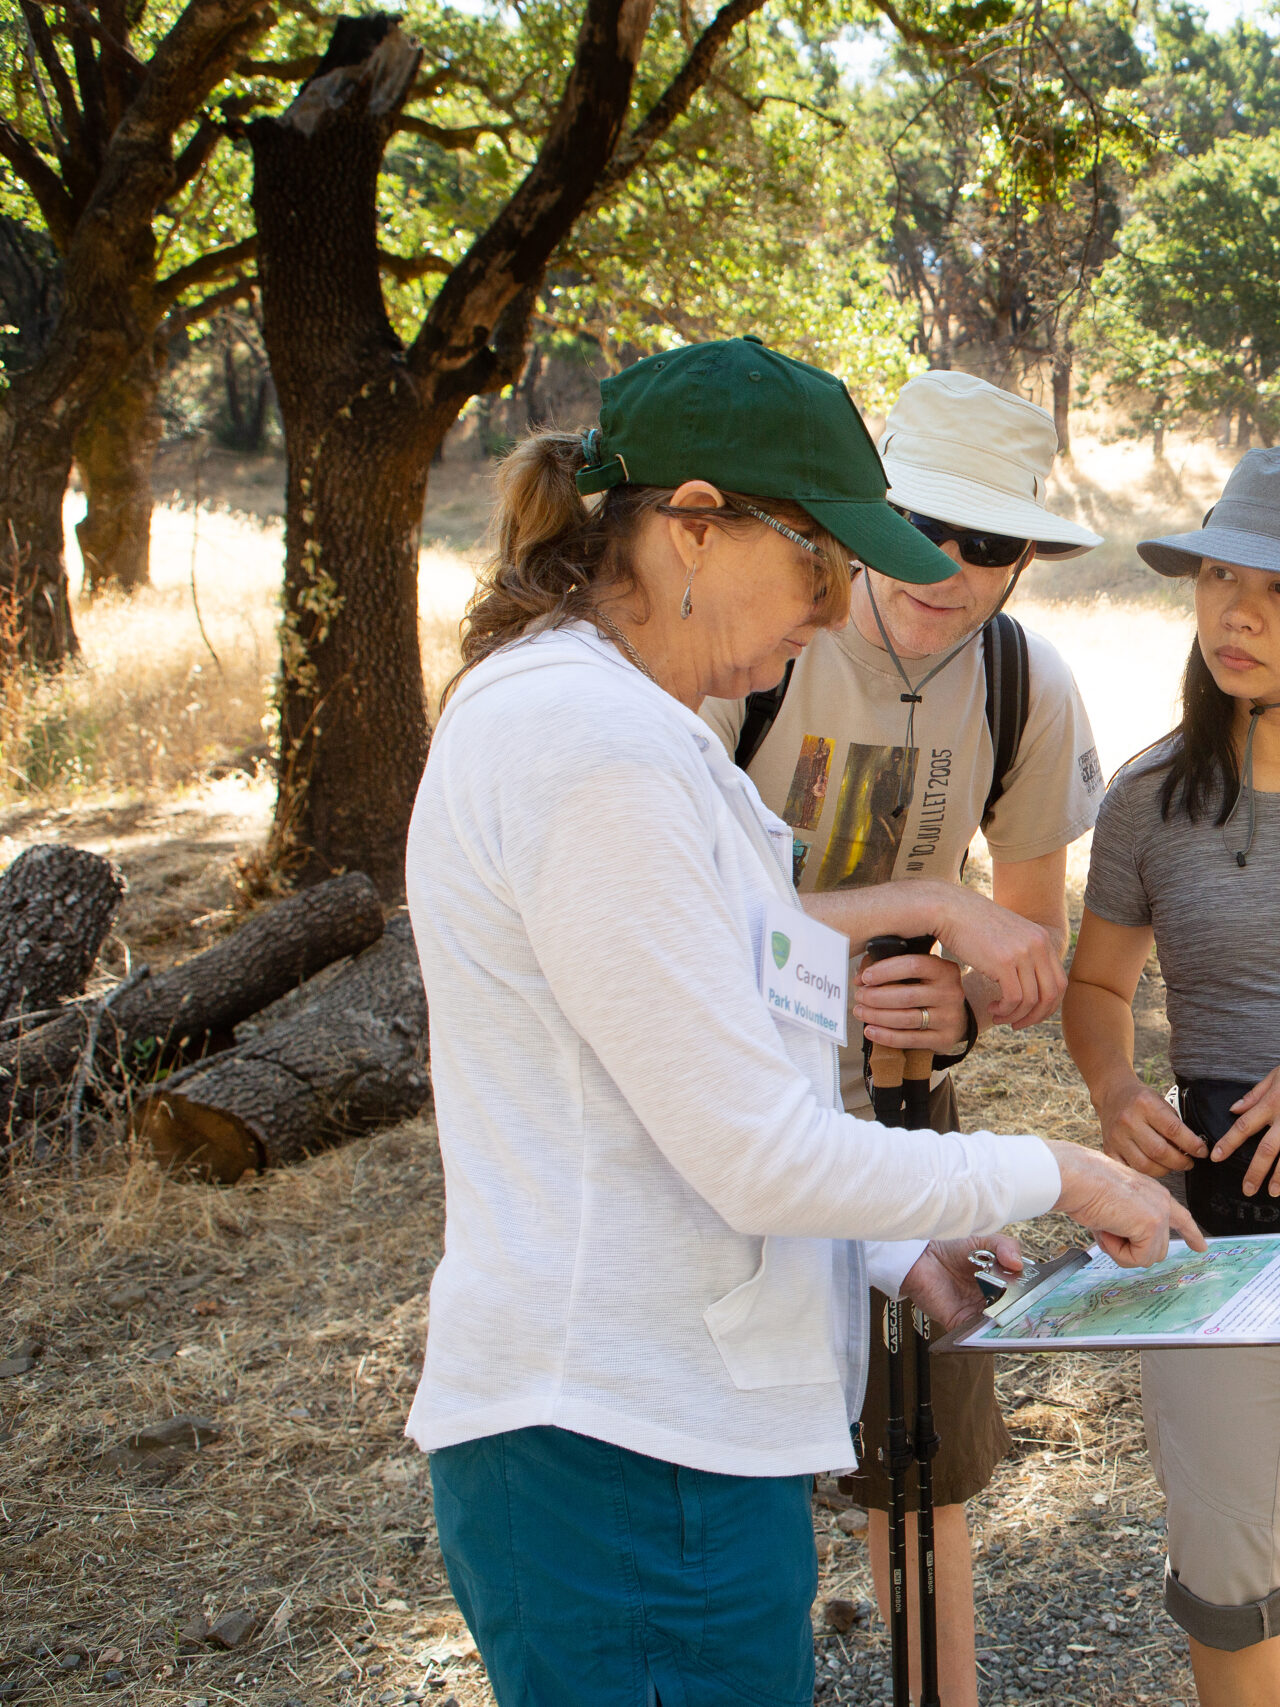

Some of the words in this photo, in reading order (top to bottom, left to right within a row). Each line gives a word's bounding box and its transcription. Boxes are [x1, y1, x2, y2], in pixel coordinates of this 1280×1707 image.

[928, 748, 953, 790] 2005
[917, 791, 946, 843] JUILLET
[795, 963, 841, 999] Carolyn
[768, 987, 791, 1012] Park
[794, 999, 839, 1033] Volunteer
